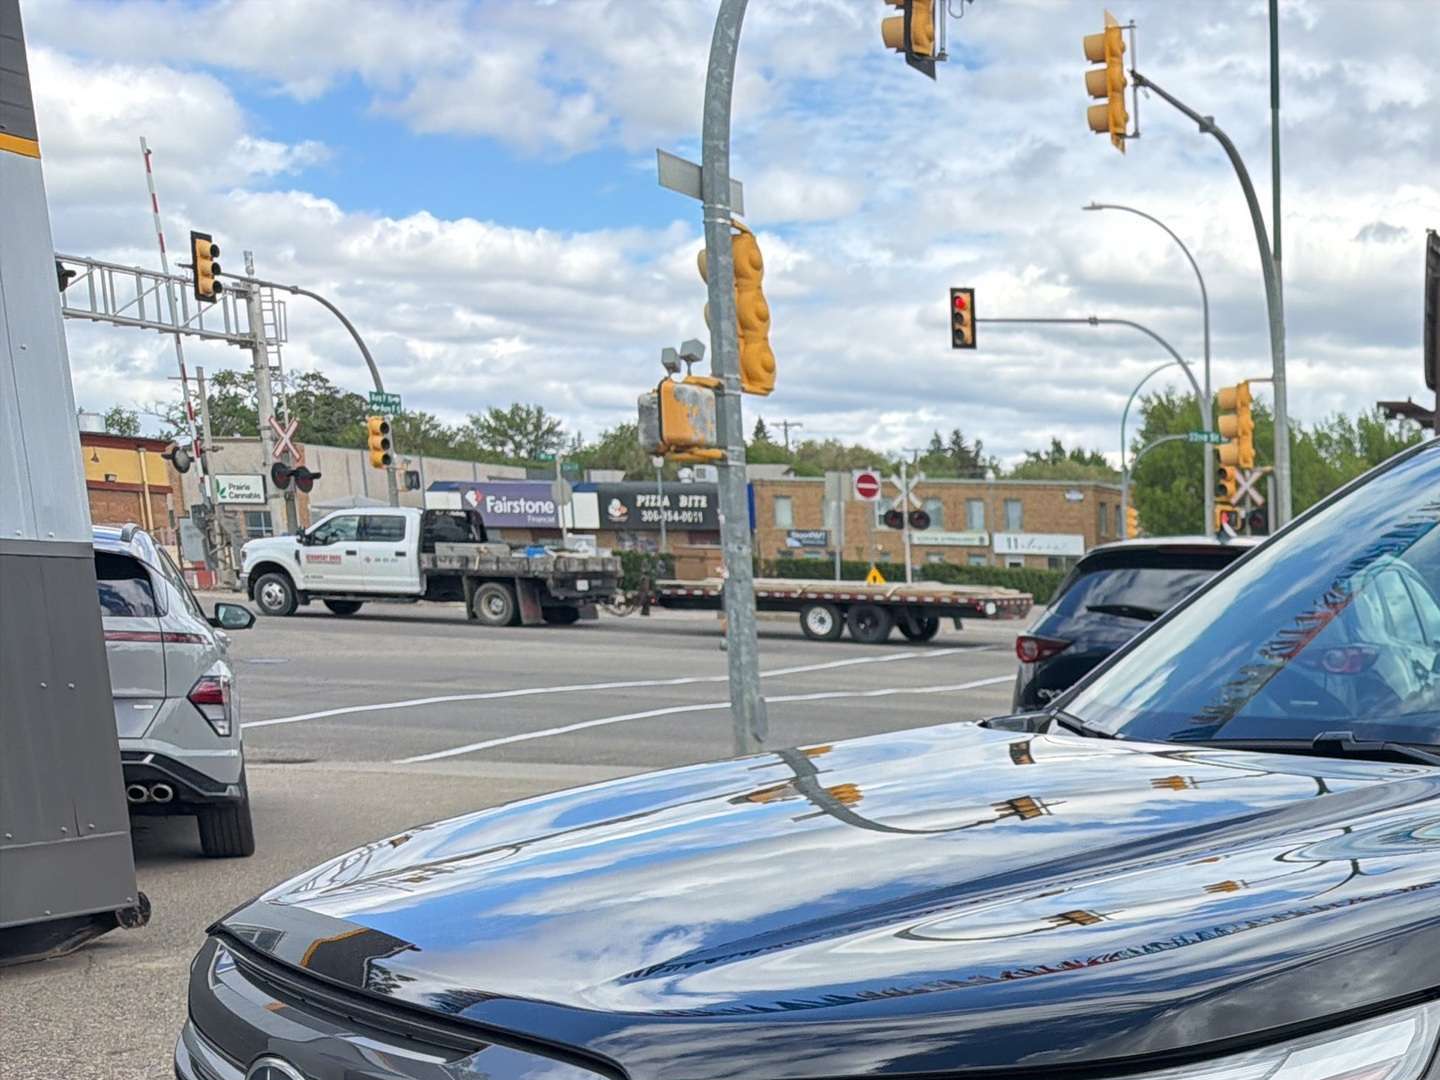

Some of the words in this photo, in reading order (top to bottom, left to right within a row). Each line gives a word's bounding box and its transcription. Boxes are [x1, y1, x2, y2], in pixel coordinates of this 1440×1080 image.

[228, 482, 250, 491] Prairie
[228, 491, 261, 499] Cannabis
[486, 495, 555, 514] Fairstone
[679, 495, 708, 508] BITE
